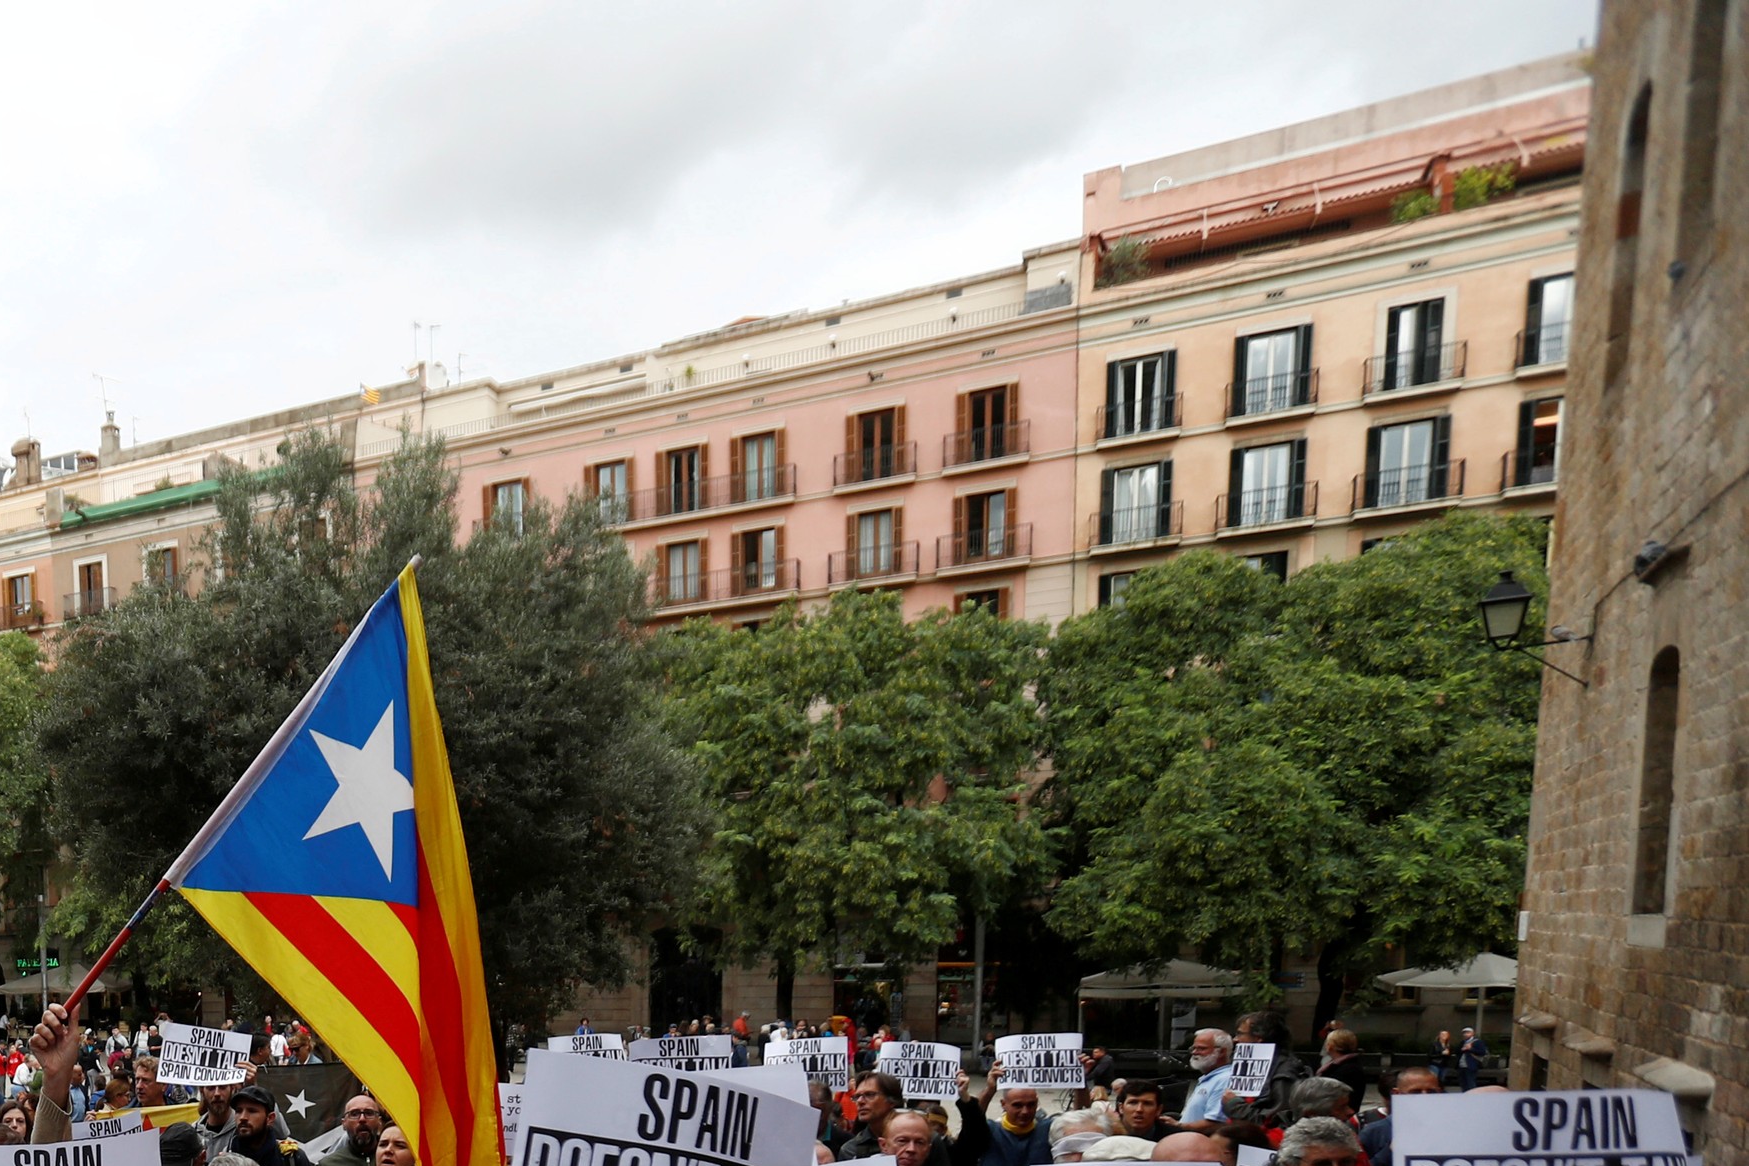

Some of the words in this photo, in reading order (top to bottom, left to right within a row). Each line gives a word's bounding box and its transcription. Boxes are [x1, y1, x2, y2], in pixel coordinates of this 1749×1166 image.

[17, 958, 59, 968] FACIA
[191, 1028, 225, 1048] SPAIN
[572, 1035, 603, 1050] SPAIN
[789, 1039, 821, 1054] SPAIN
[1021, 1035, 1056, 1049] SPAIN
[164, 1041, 213, 1067] DOESN'T
[659, 1038, 700, 1057] SPAIN
[901, 1044, 935, 1058] SPAIN
[1235, 1045, 1254, 1058] AIN
[815, 1054, 845, 1071] TALK
[880, 1060, 924, 1077] DOESN'T
[929, 1061, 958, 1078] TALK
[1246, 1060, 1270, 1076] TALK
[160, 1062, 191, 1080] SPAIN
[194, 1068, 244, 1081] CONVICTS
[1032, 1068, 1082, 1083] CONVICTS
[907, 1078, 956, 1095] CONVICTS
[637, 1073, 759, 1161] SPAIN
[1512, 1096, 1638, 1152] SPAIN
[89, 1118, 122, 1137] SPAIN
